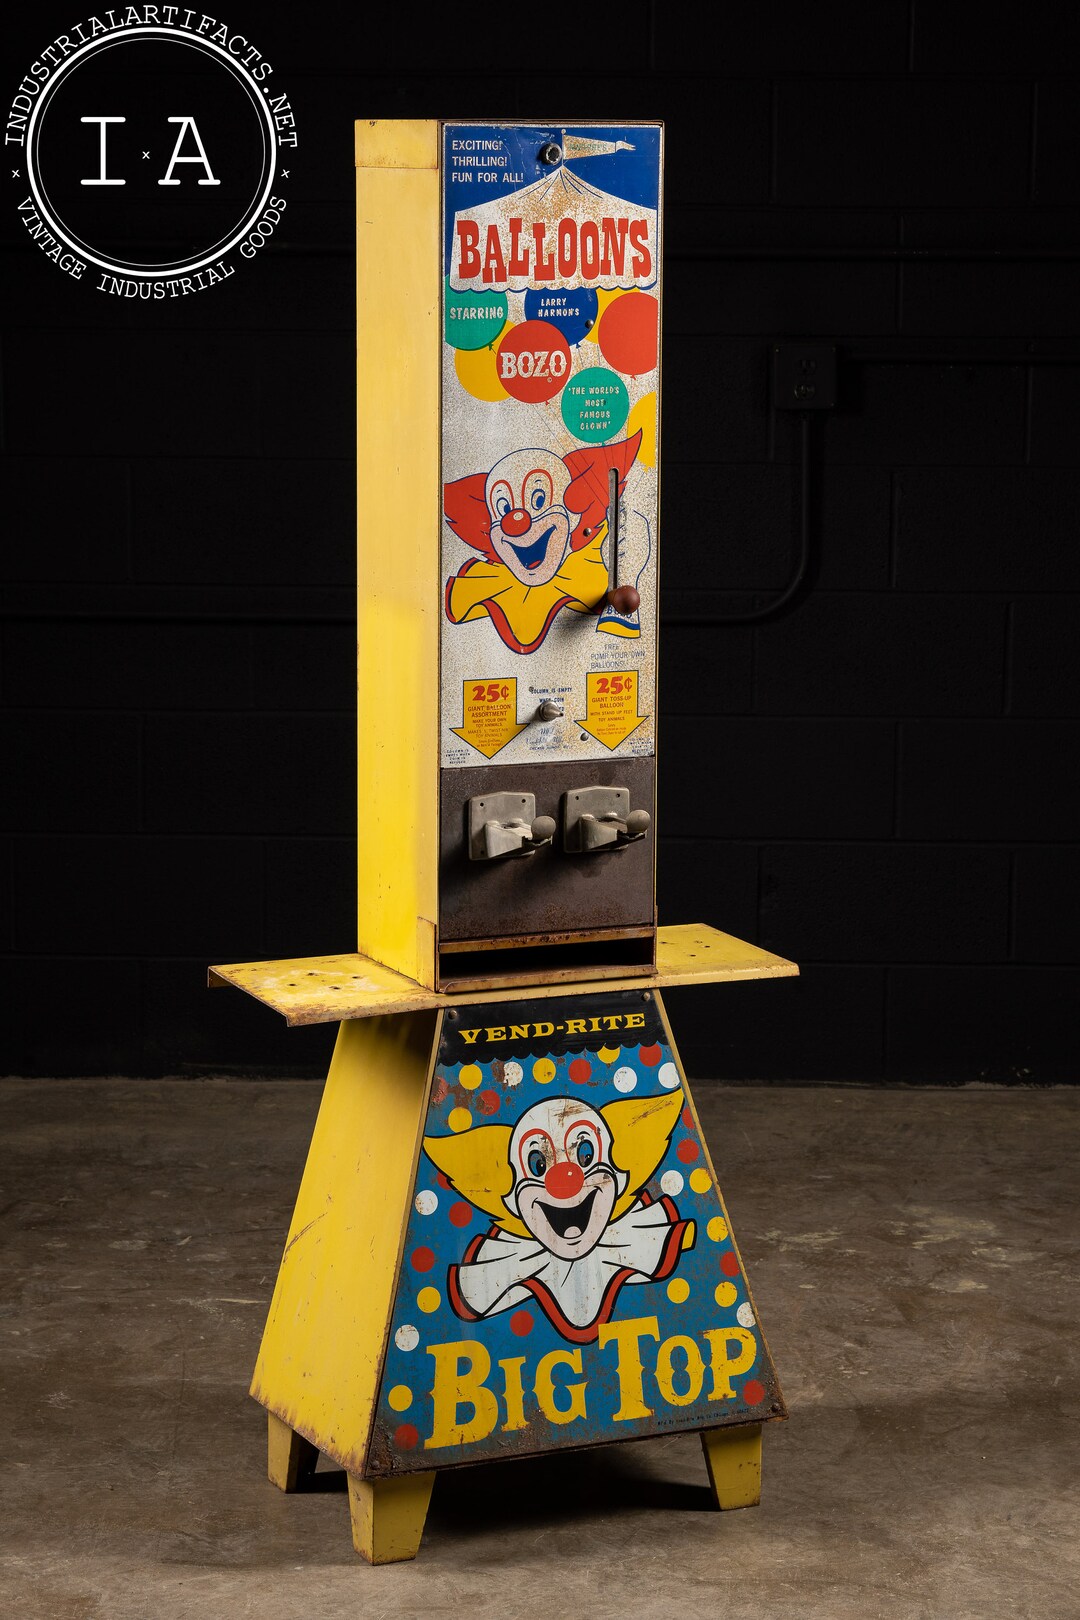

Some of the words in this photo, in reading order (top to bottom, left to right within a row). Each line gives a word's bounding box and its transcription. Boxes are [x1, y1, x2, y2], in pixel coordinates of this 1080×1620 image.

[452, 140, 503, 151] EXCITING!
[452, 156, 508, 167] THRILLING!
[452, 172, 473, 183] FUN
[478, 172, 498, 183] FOR
[503, 172, 524, 183] ALL!
[457, 218, 652, 283] BALLOONS
[541, 298, 567, 307] LARRY
[450, 307, 504, 320] STARRING
[538, 308, 580, 318] HARMON'S
[500, 350, 568, 379] BOZO
[585, 399, 605, 407] MOST
[580, 411, 611, 419] FAMOUS
[596, 676, 633, 695] 25¢
[472, 684, 510, 702] 25¢
[458, 1013, 646, 1044] VEND-RITE
[424, 1339, 587, 1450] BIG
[599, 1315, 757, 1422] TOP
